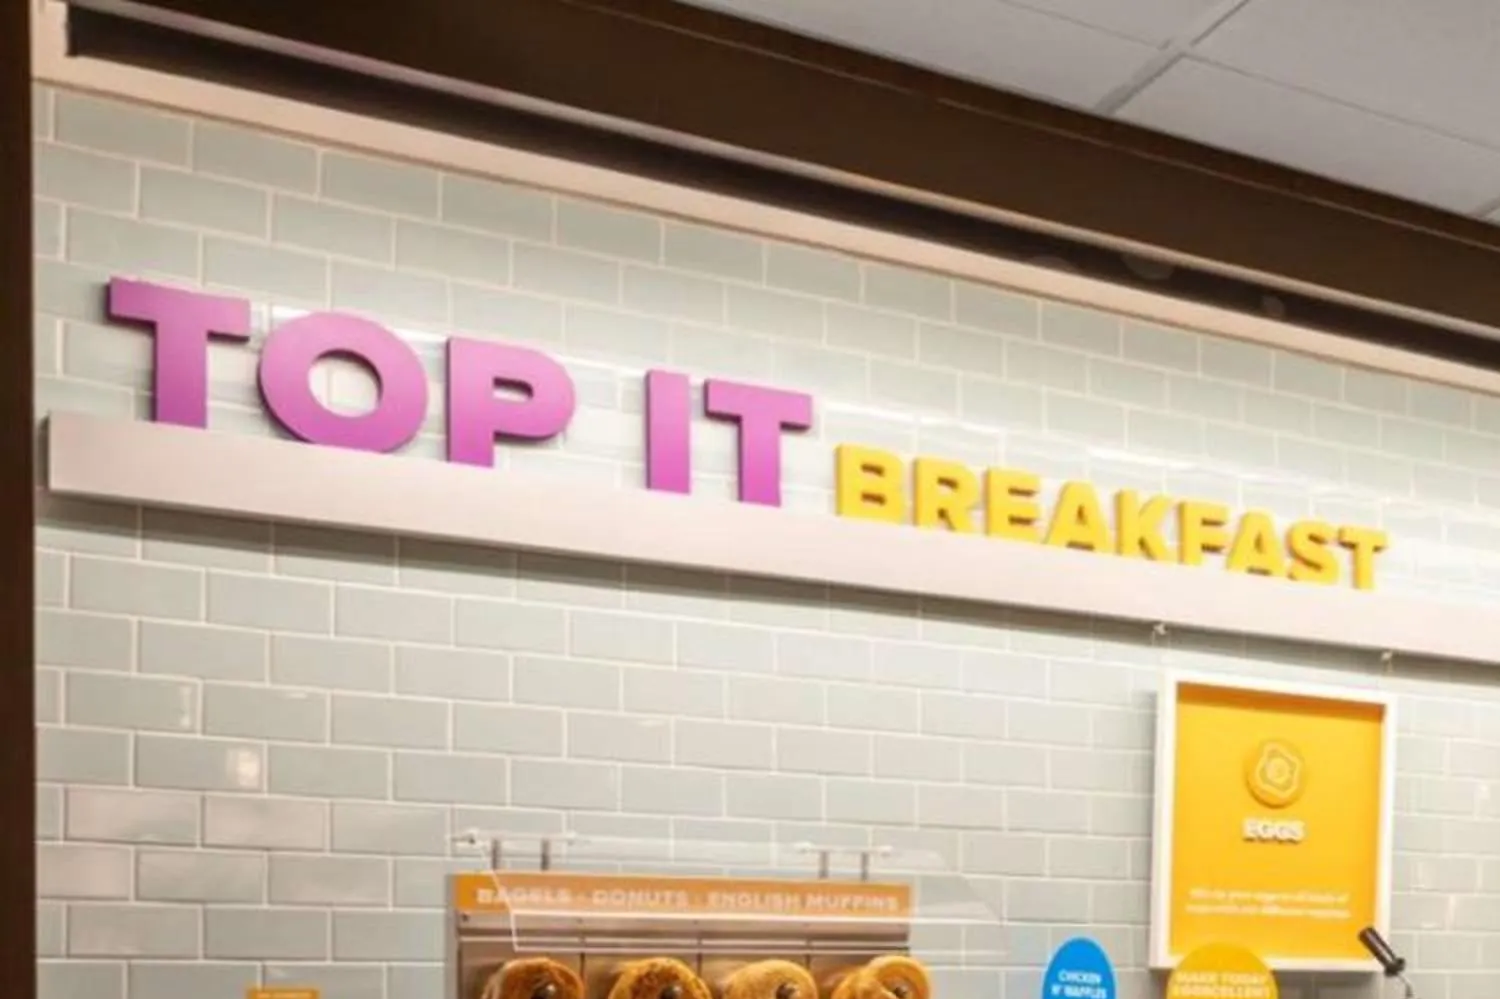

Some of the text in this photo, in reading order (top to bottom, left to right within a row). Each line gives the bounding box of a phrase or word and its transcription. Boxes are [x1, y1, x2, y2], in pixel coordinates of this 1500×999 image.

[105, 275, 1388, 591] TOP IT BREAKFAST
[1242, 817, 1306, 842] EGGS
[477, 886, 899, 913] BAGELS DONUTS ENGLISH MUFFINS
[1057, 969, 1102, 985] CHICKEN
